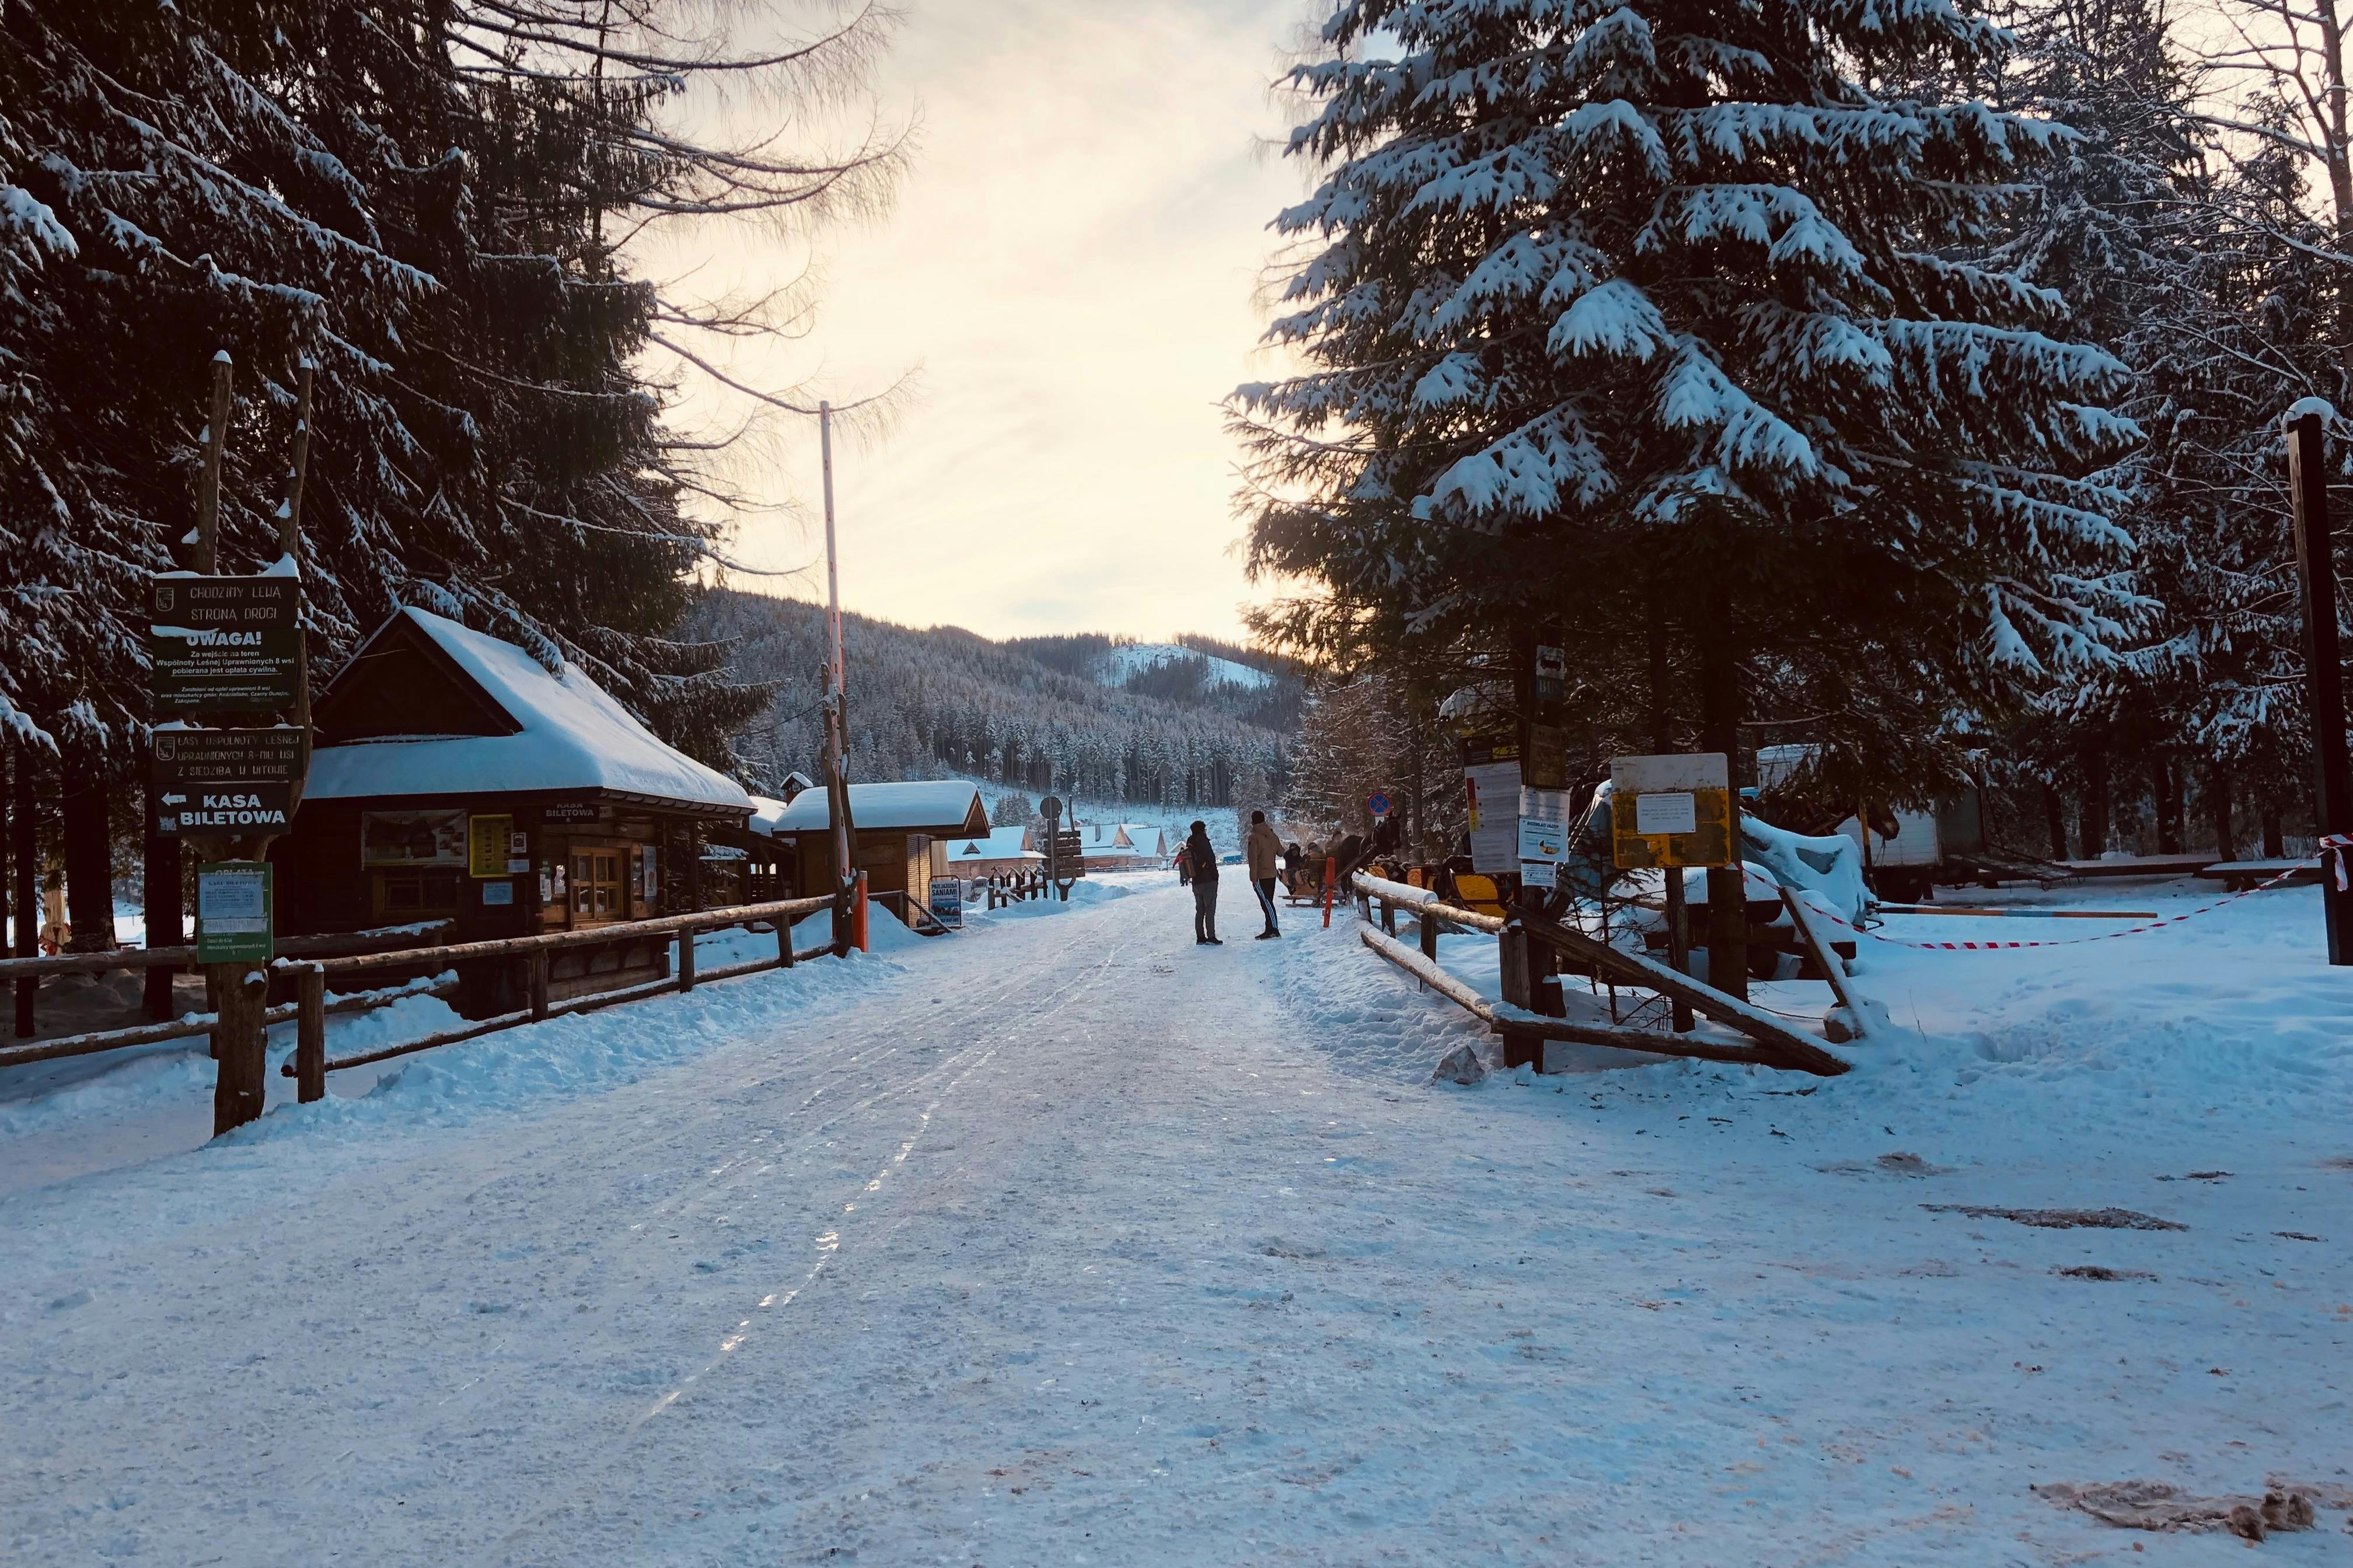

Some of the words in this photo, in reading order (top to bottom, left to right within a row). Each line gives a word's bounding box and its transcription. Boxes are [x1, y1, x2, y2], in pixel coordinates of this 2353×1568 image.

[190, 586, 243, 599] CHODZIMY
[245, 607, 277, 620] DROGI
[187, 632, 261, 646] UWAGA!
[156, 659, 195, 667] Wspólnoty
[222, 658, 274, 666] Uprawnionych
[172, 667, 208, 676] pobierana
[177, 766, 184, 777] Z
[203, 794, 261, 809] KASA
[180, 810, 286, 825] BILETOWA
